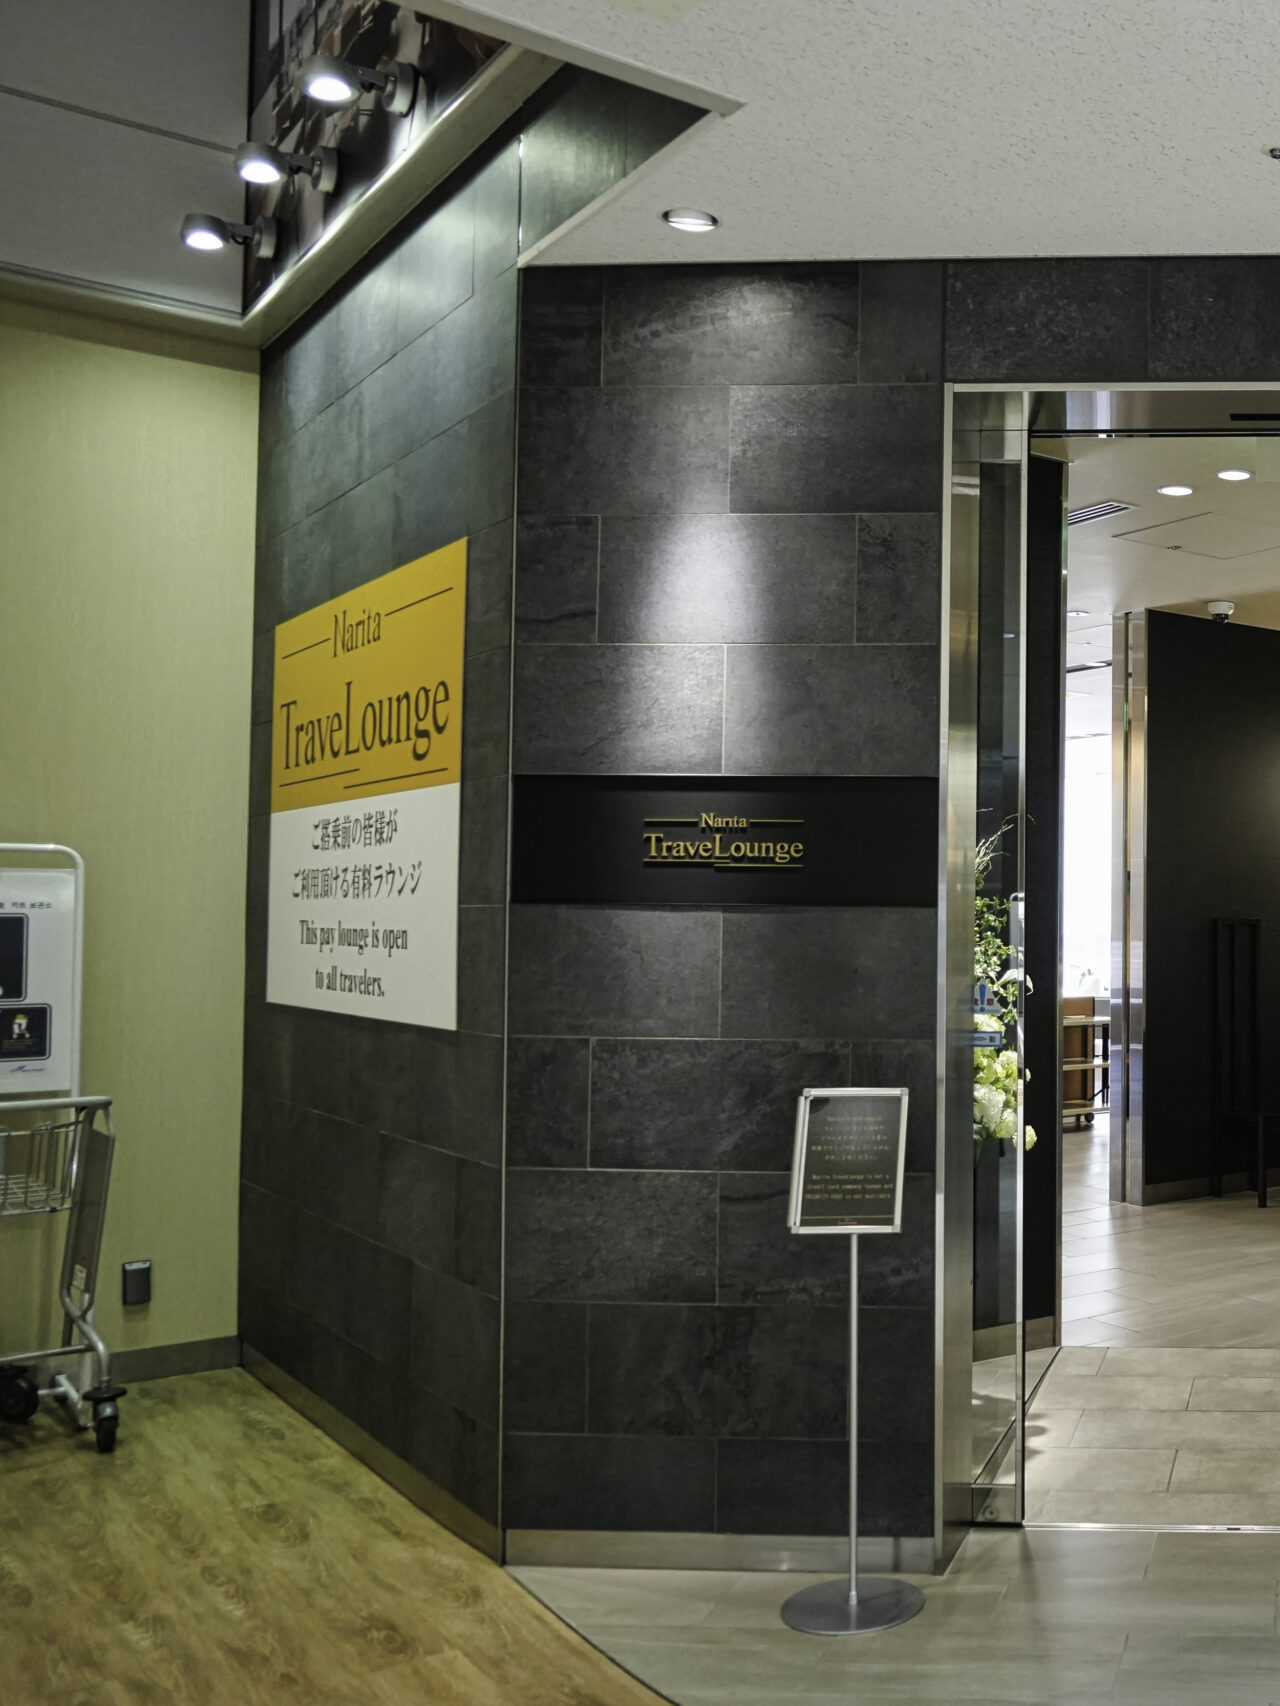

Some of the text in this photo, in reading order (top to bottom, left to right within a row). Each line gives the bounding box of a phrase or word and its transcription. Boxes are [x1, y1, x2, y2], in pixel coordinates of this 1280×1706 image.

[332, 607, 382, 659] Narita
[280, 679, 450, 770] TraveLounge
[312, 808, 399, 851] ご搭乗前の皆様が
[701, 813, 748, 828] Narita
[643, 834, 804, 863] TraveLounge
[292, 860, 422, 900] ご利用頂ける有料ラウンジ
[299, 919, 408, 957] This pay lounge is open
[315, 965, 385, 997] to all travelers.
